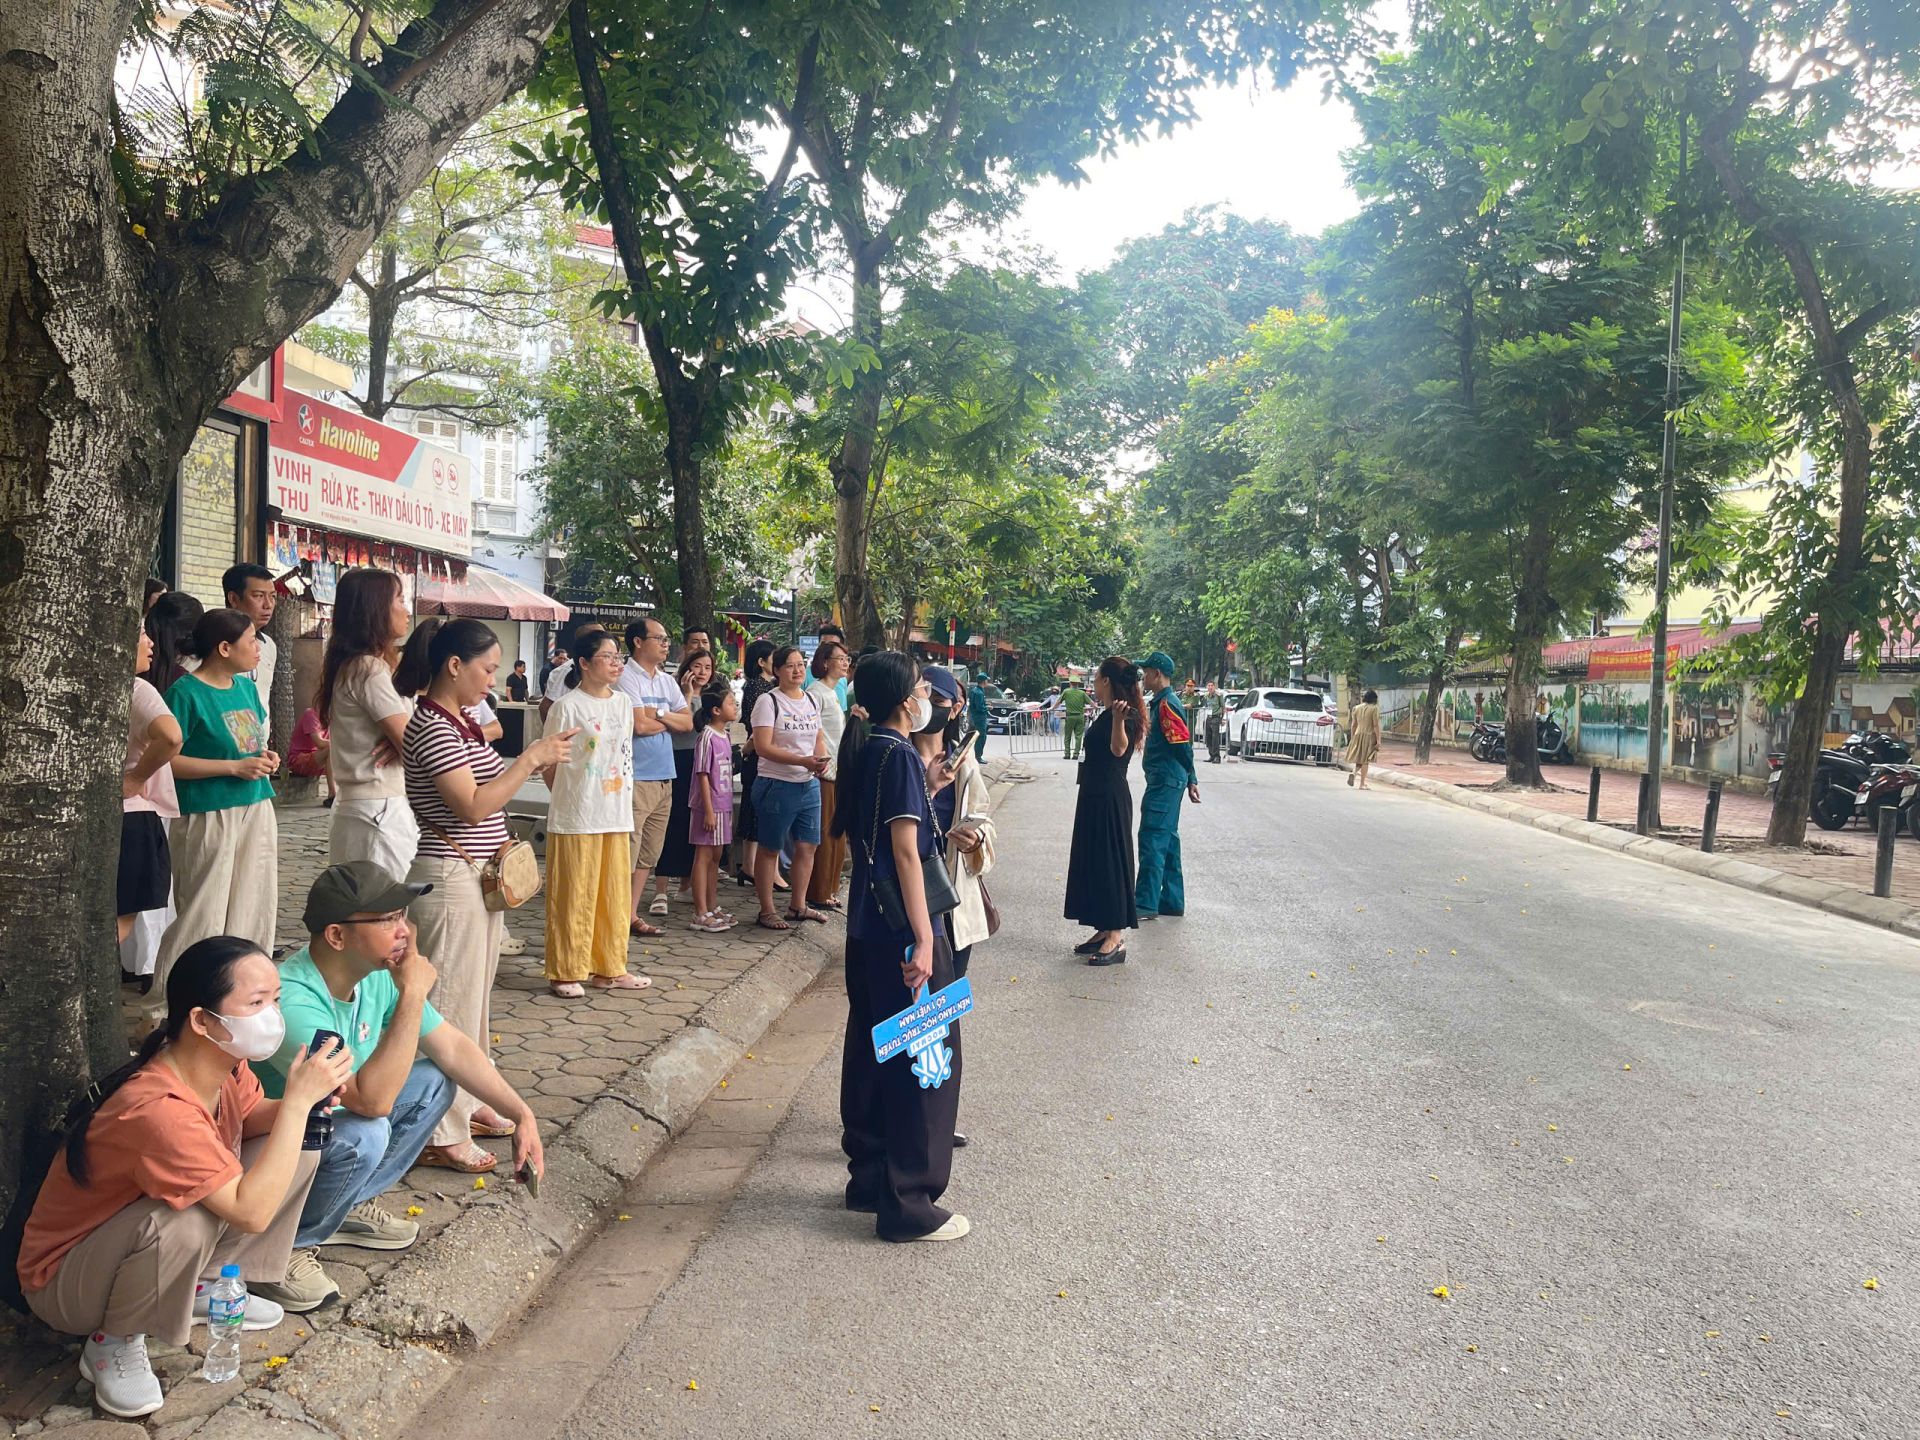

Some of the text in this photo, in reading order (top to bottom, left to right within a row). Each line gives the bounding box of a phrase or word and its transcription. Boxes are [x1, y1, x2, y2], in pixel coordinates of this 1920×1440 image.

[319, 416, 380, 462] Havoline
[273, 455, 312, 486] VINH
[276, 485, 309, 513] THU
[346, 484, 359, 511] XE
[368, 490, 394, 520] THAY
[415, 498, 421, 527] Ô
[423, 502, 434, 530] TÔ
[441, 511, 451, 534] XE
[452, 512, 468, 538] MÁY
[575, 606, 591, 615] MAN
[599, 608, 626, 617] BARBER
[915, 1002, 931, 1019] VIỆT
[936, 994, 947, 1010] SỐ
[898, 1012, 915, 1028] NAM
[920, 1014, 938, 1030] HỌC
[911, 1028, 944, 1051] HOCMAI
